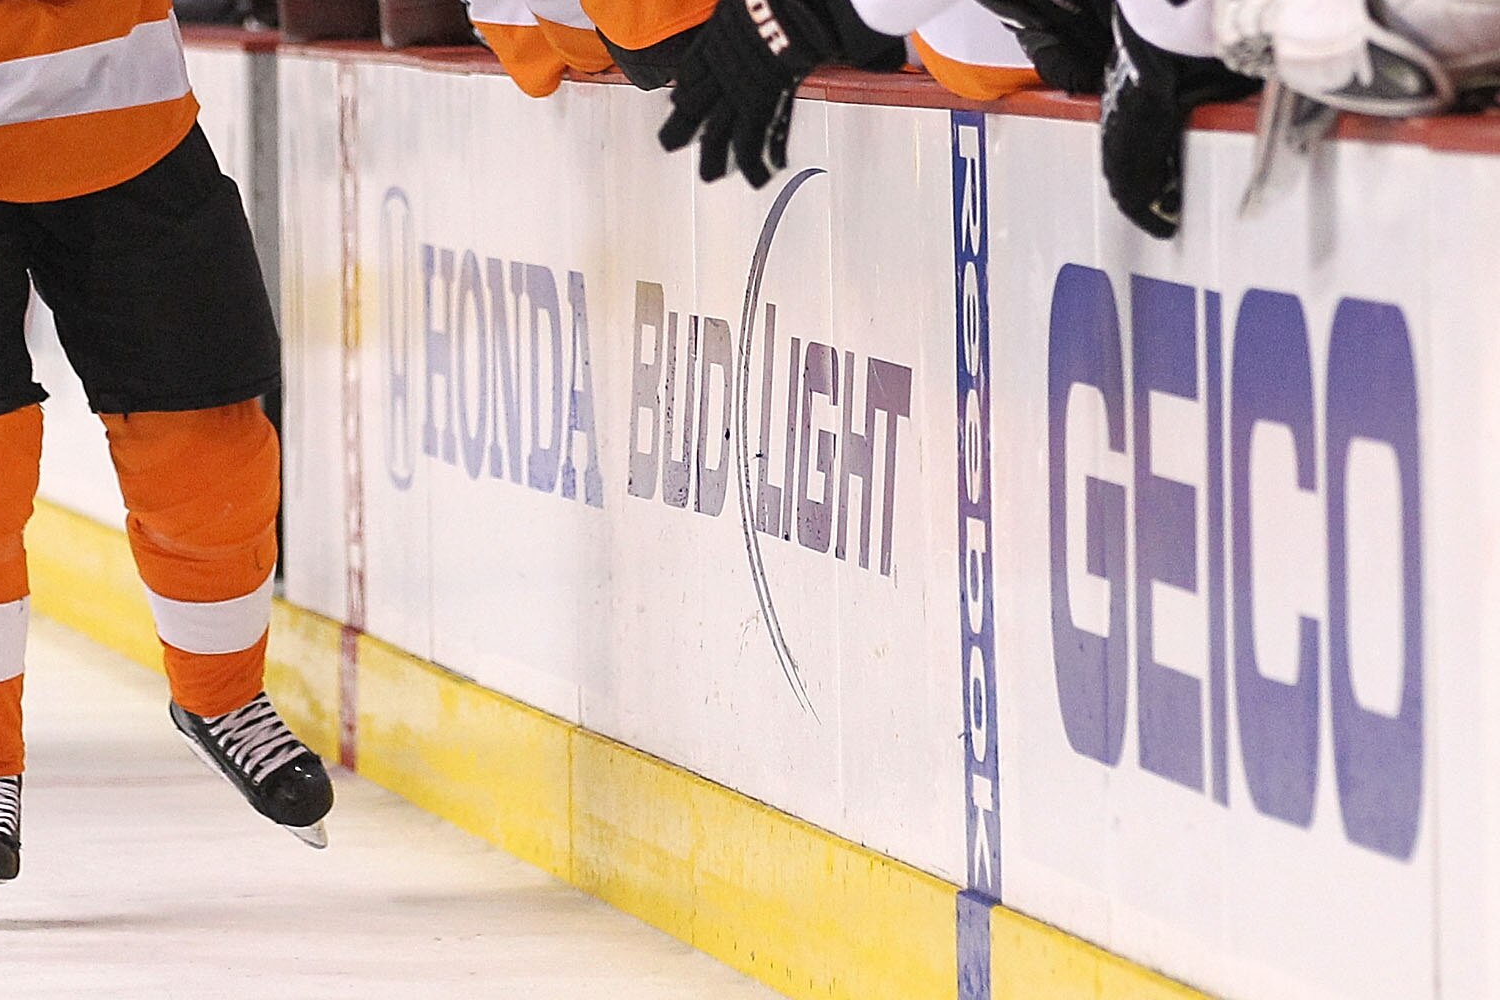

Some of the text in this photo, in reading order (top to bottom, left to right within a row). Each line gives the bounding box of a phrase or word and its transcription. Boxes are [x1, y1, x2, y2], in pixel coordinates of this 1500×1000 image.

[421, 243, 604, 510] HONDA
[627, 279, 913, 578] BUD LIGHT
[1047, 262, 1427, 864] GEICO
